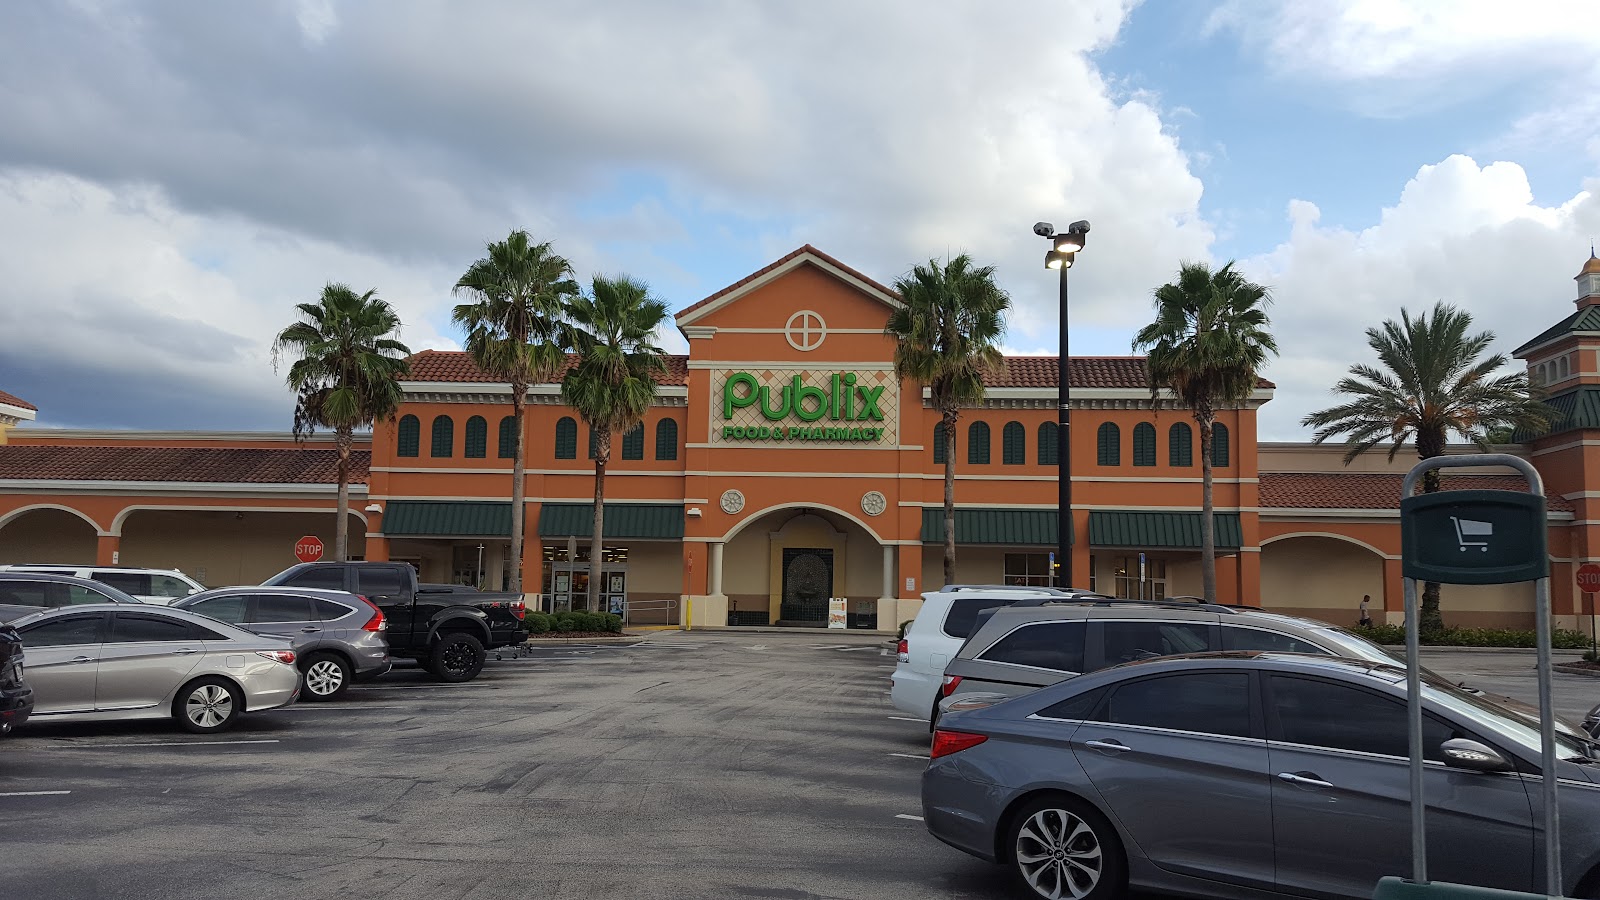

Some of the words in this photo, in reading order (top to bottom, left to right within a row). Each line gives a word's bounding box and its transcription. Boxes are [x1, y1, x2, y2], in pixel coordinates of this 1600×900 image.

[724, 372, 885, 421] Publix
[723, 426, 770, 440] FOOD
[773, 427, 785, 441] &
[788, 427, 885, 441] PHARMACY
[296, 544, 322, 555] STOP
